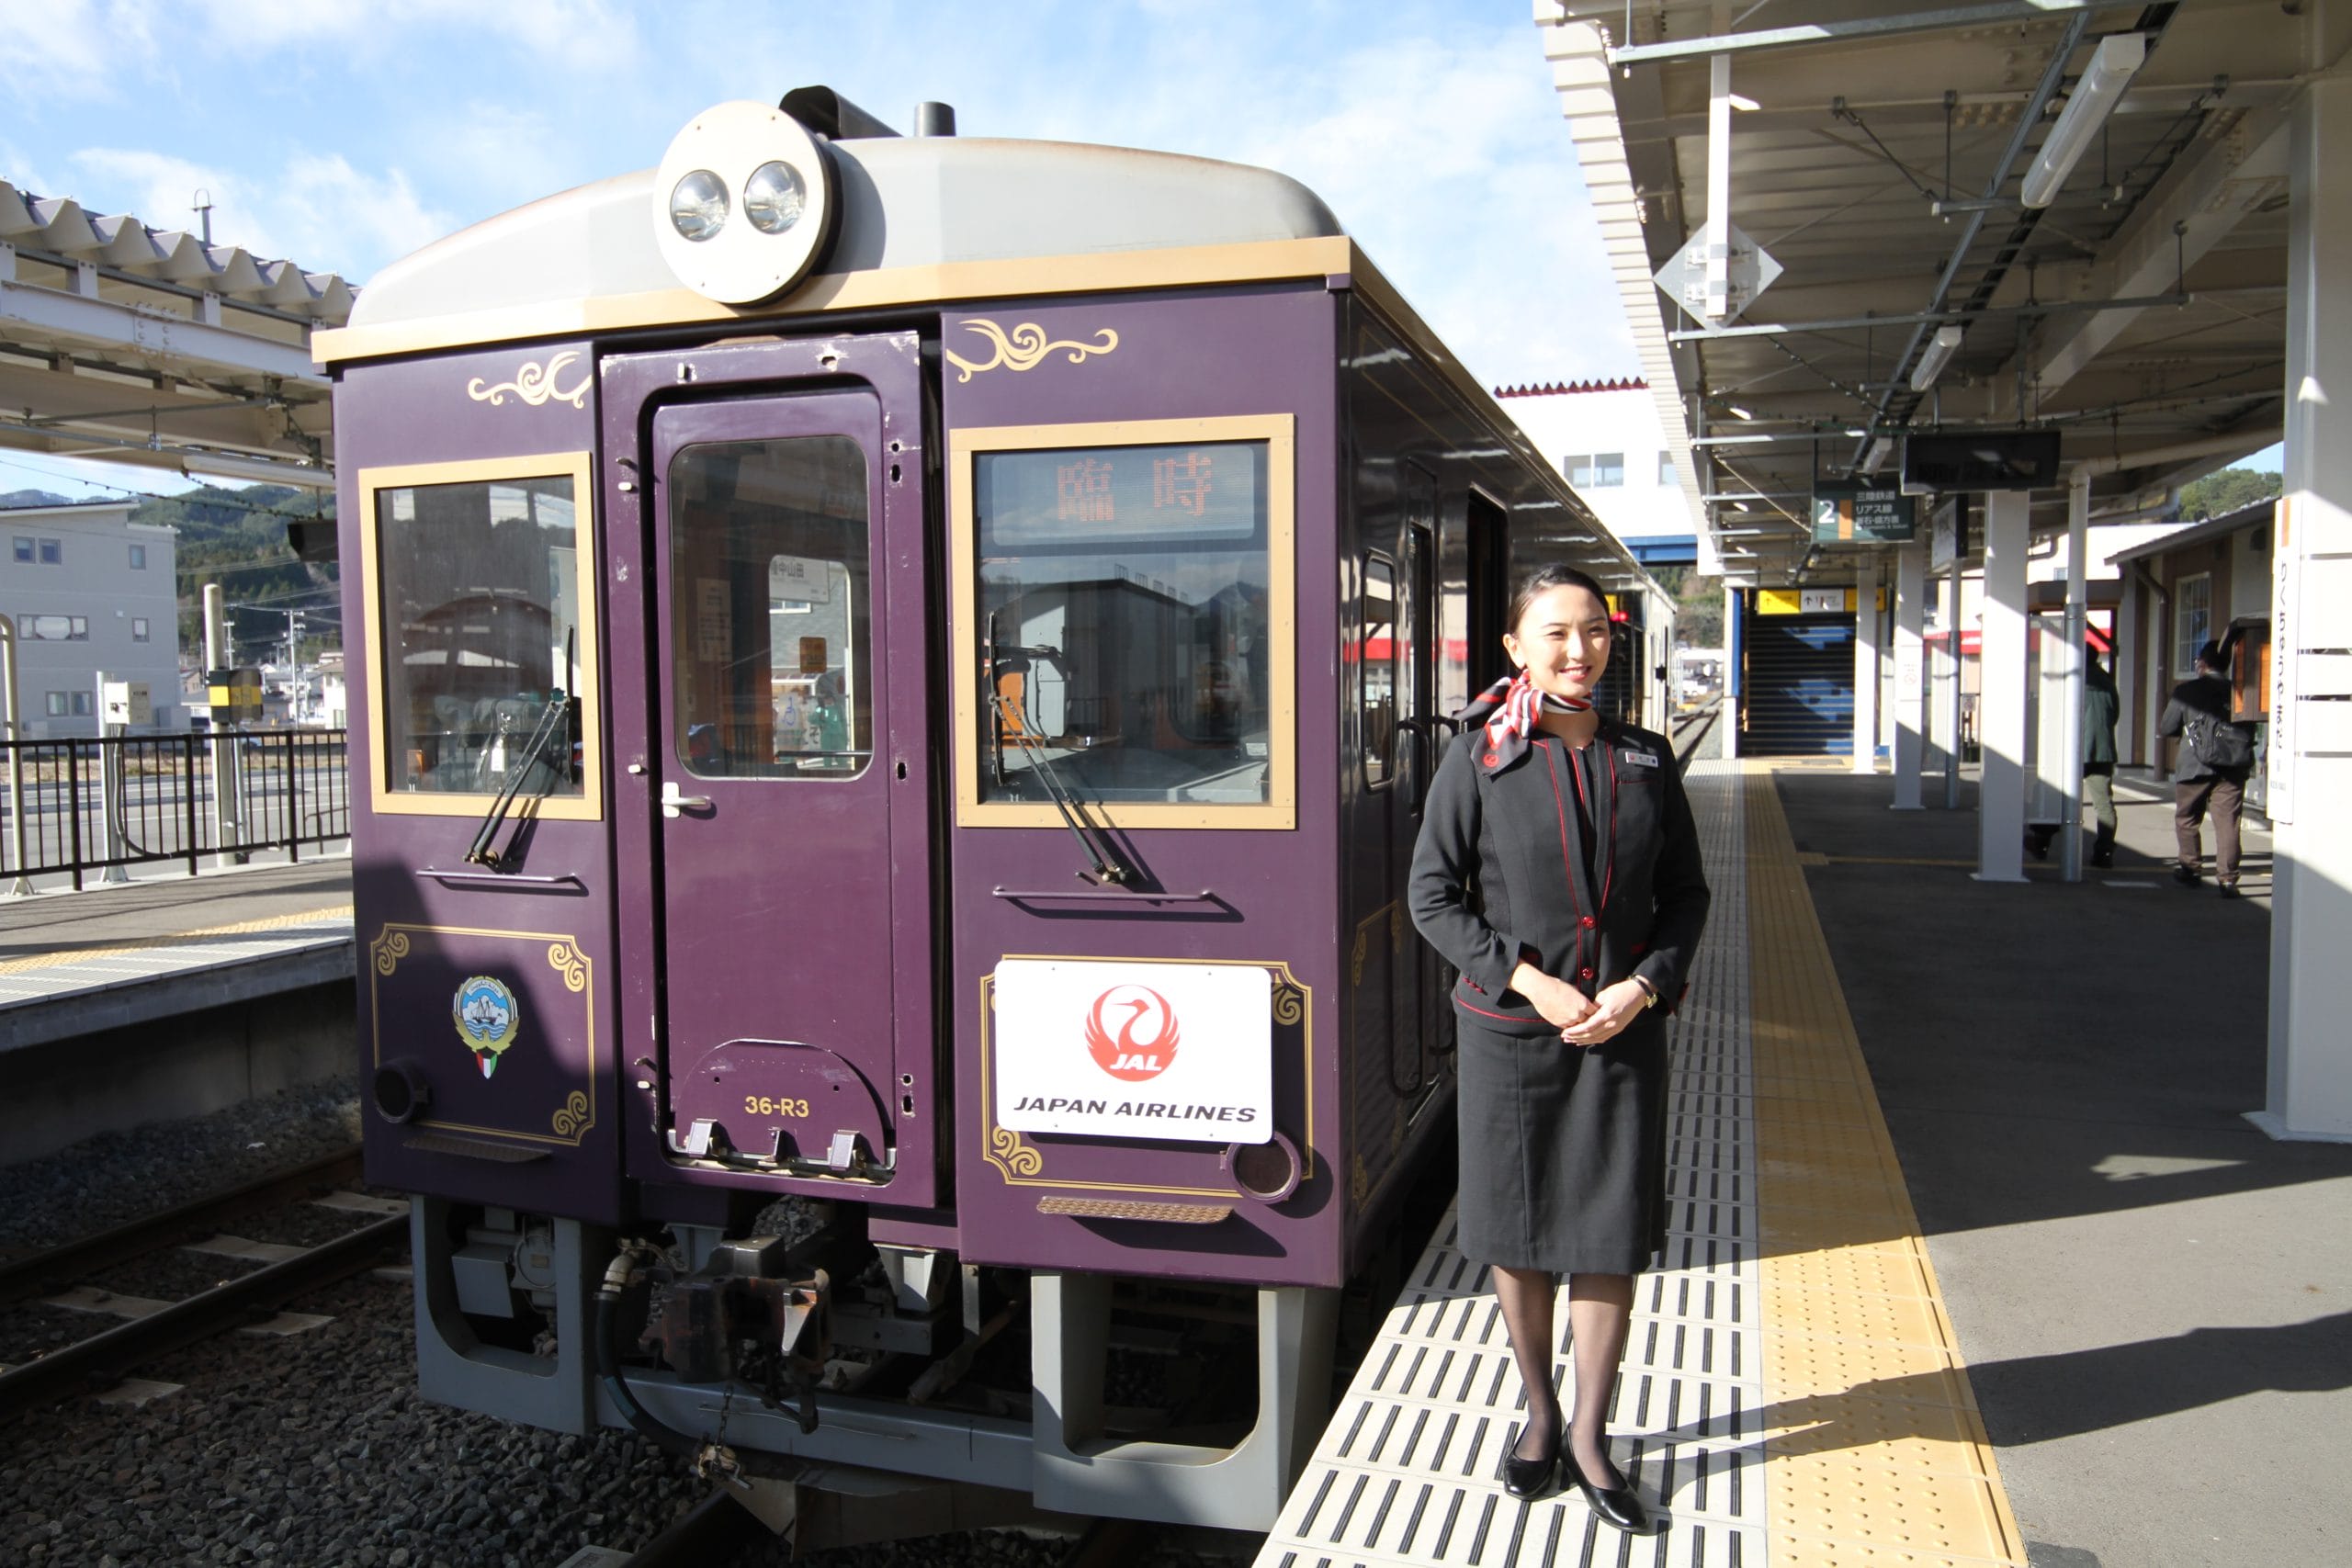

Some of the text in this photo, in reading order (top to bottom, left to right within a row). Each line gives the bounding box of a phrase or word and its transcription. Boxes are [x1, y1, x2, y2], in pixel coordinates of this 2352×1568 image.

[1818, 500, 1836, 524] 2
[1109, 1053, 1162, 1072] JAL
[744, 1096, 809, 1118] 36-R3
[1013, 1097, 1258, 1122] JAPAN AIRLINES
